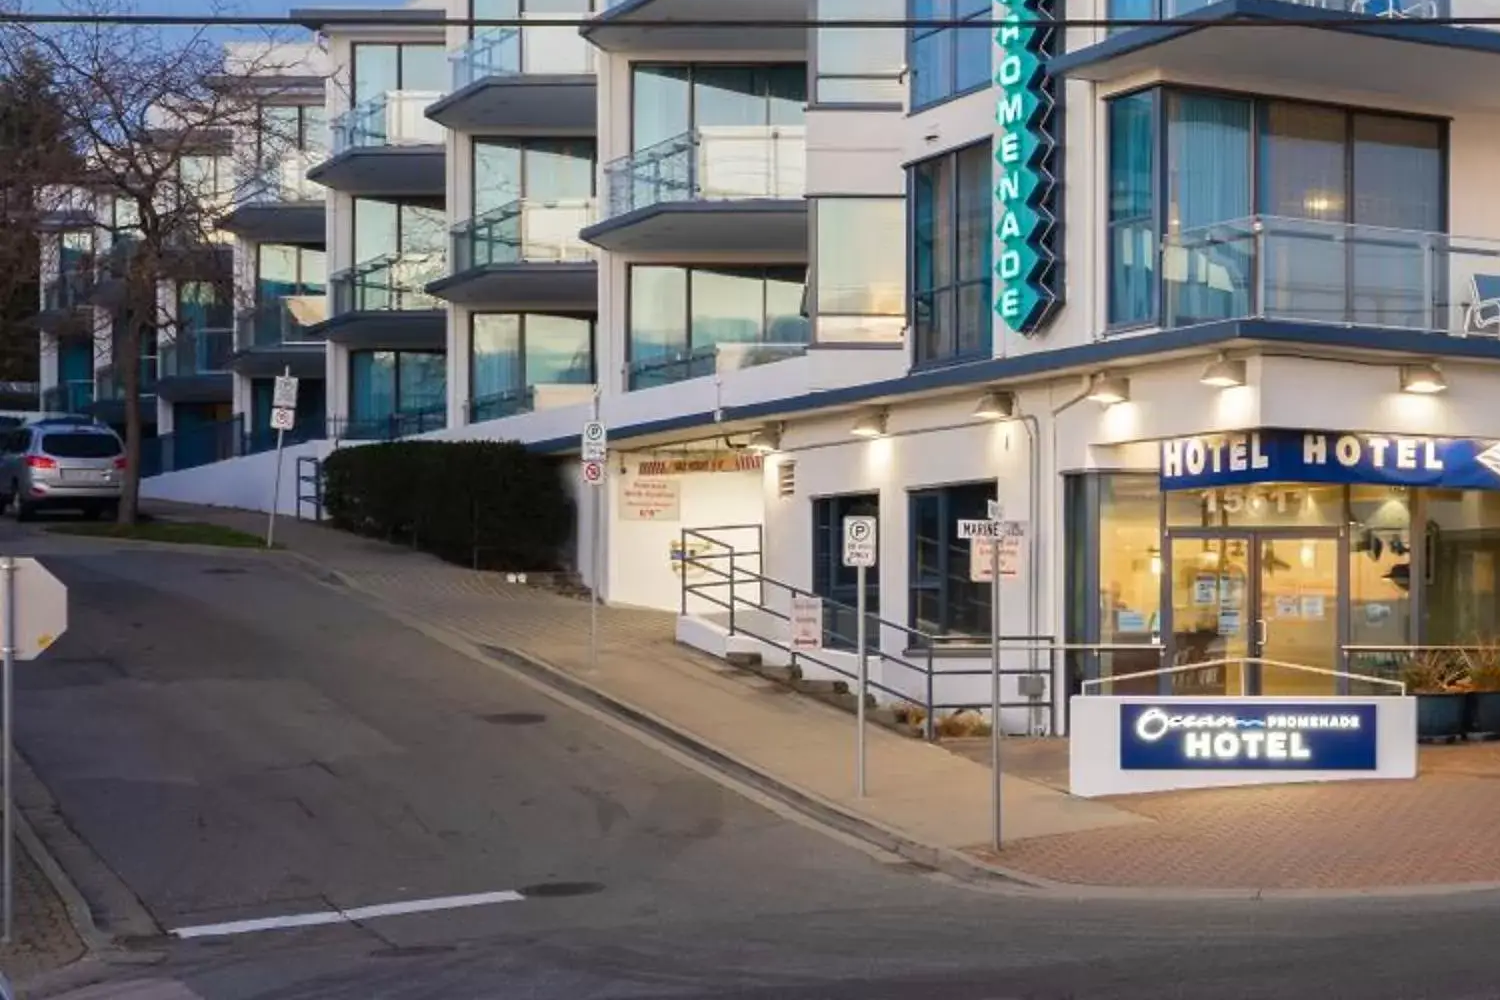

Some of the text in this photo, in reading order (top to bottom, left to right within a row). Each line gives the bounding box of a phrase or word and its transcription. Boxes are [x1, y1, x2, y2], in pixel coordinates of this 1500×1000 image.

[1162, 432, 1443, 477] HOTEL HOTEL
[963, 522, 999, 536] MARINE
[1136, 708, 1361, 741] Ocean PROMENADE
[1184, 730, 1312, 760] HOTEL
